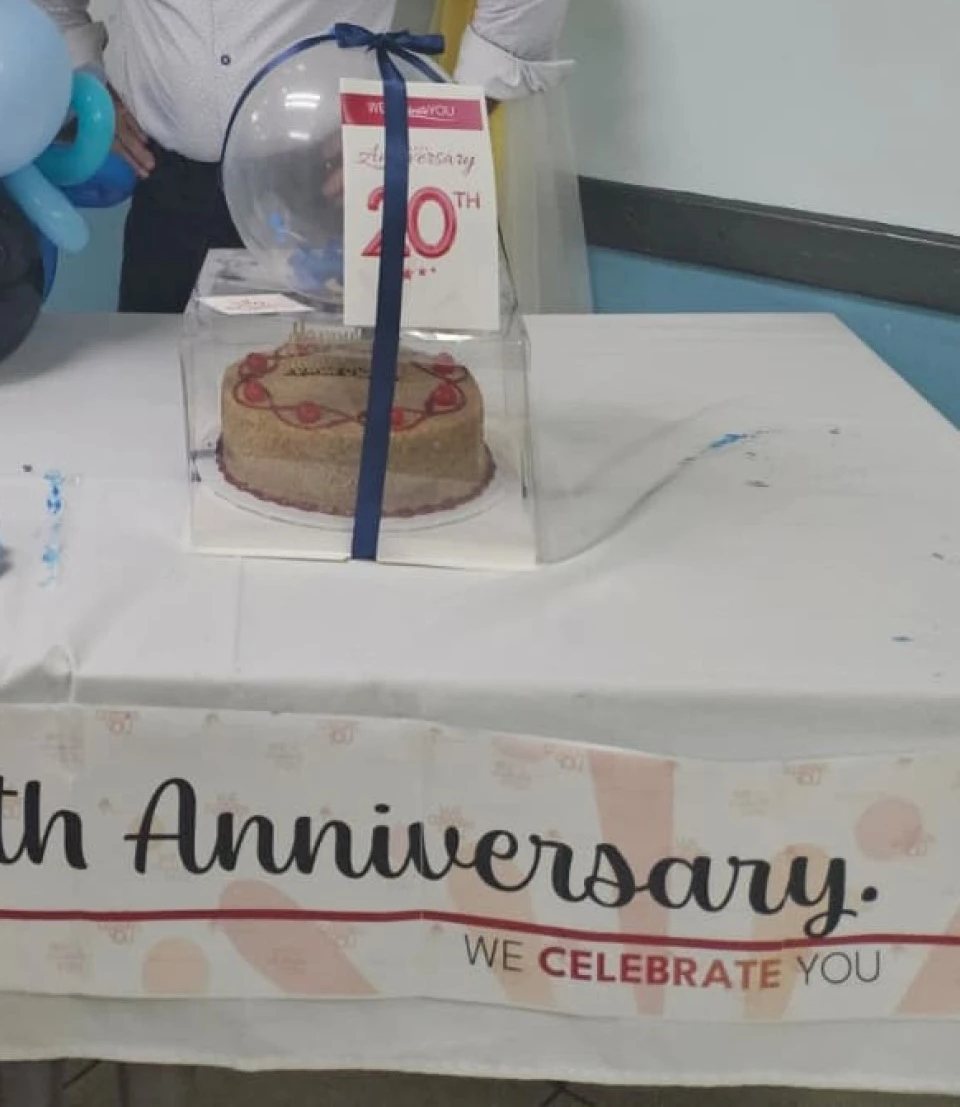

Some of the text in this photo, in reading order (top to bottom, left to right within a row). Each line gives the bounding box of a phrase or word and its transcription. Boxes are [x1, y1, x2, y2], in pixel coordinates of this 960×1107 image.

[124, 777, 879, 939] Anniversary.
[464, 933, 882, 989] WE CELEBRATE YOU
